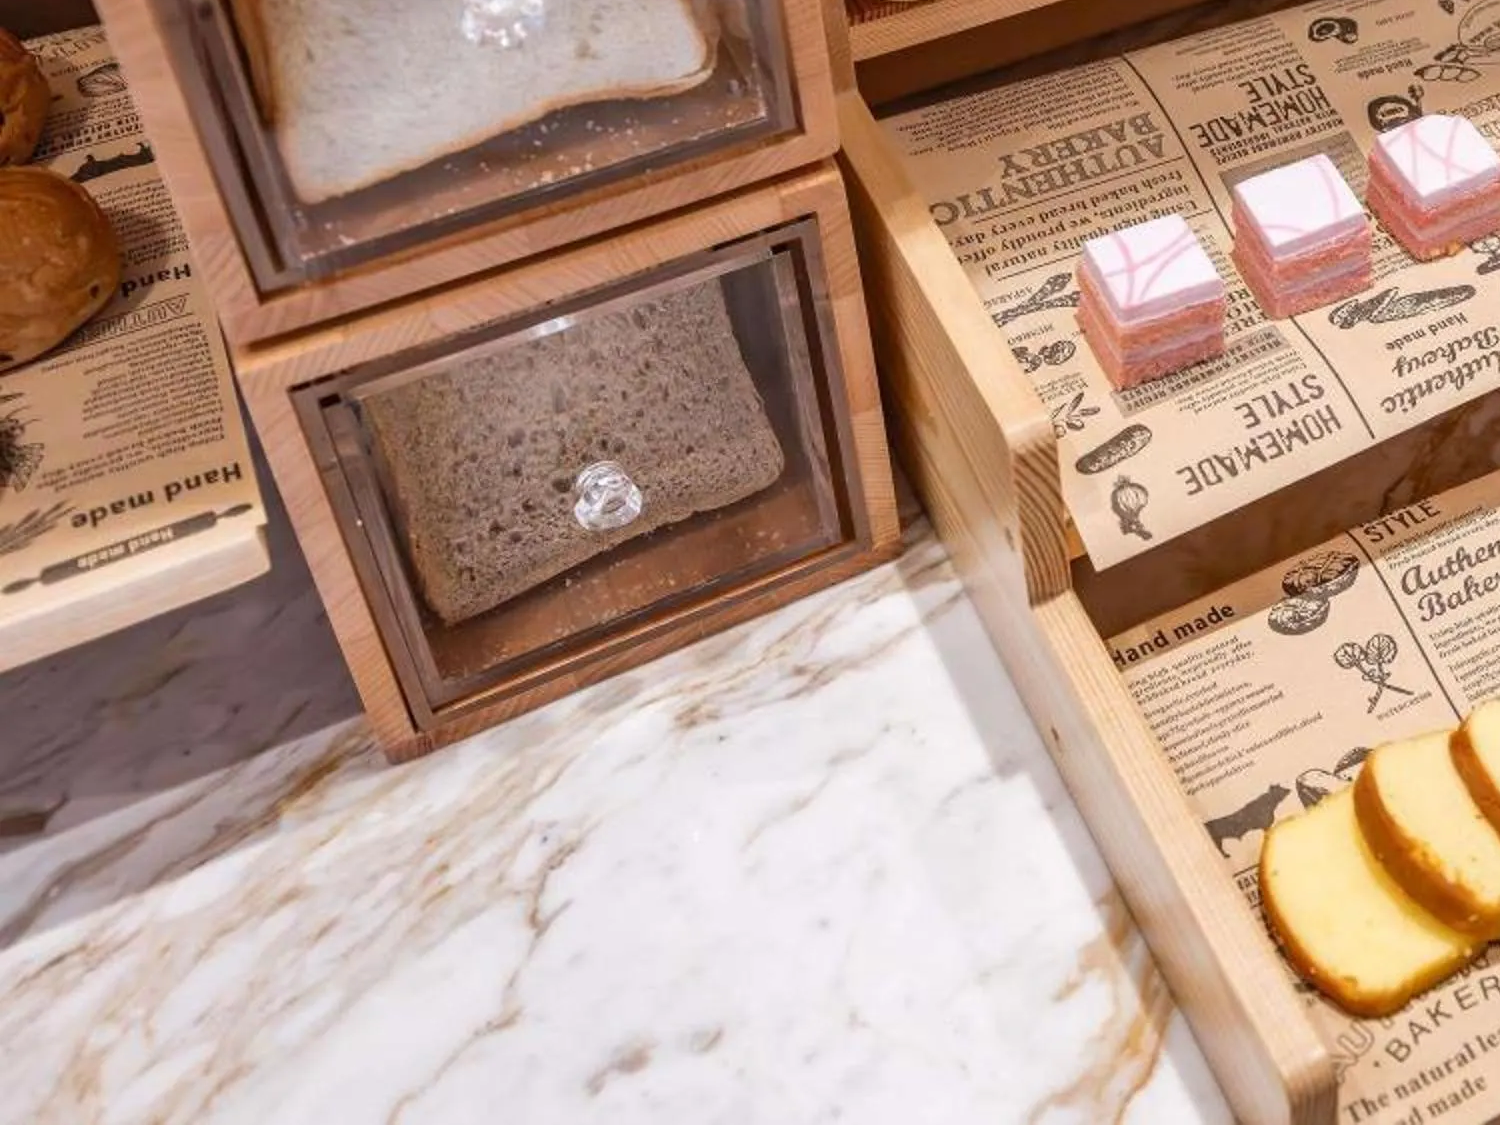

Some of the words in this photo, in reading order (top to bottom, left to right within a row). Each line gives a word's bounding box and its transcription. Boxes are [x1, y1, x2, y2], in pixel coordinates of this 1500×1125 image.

[1238, 63, 1316, 103] STYLE
[1189, 86, 1330, 148] HOMEMADE
[996, 111, 1159, 180] BAKERY
[927, 133, 1168, 227] AUTHENTIC
[1089, 183, 1139, 209] baked
[989, 214, 1035, 239] every
[1038, 199, 1087, 225] bread
[1068, 214, 1091, 230] we
[998, 221, 1066, 254] proudly
[120, 263, 190, 297] Hand
[984, 246, 1048, 276] natural
[1384, 327, 1425, 353] made
[1428, 311, 1467, 337] Hand
[1392, 325, 1499, 378] Bakery
[1234, 372, 1325, 429] STYLE
[1175, 404, 1341, 495] HOMEMADE
[162, 461, 242, 502] Hand
[69, 490, 154, 528] made
[1361, 497, 1441, 544] STYLE
[1110, 629, 1170, 669] Hand
[1173, 606, 1235, 640] made
[1344, 1082, 1401, 1125] The
[1390, 1041, 1478, 1101] natural
[1425, 1071, 1489, 1118] made
